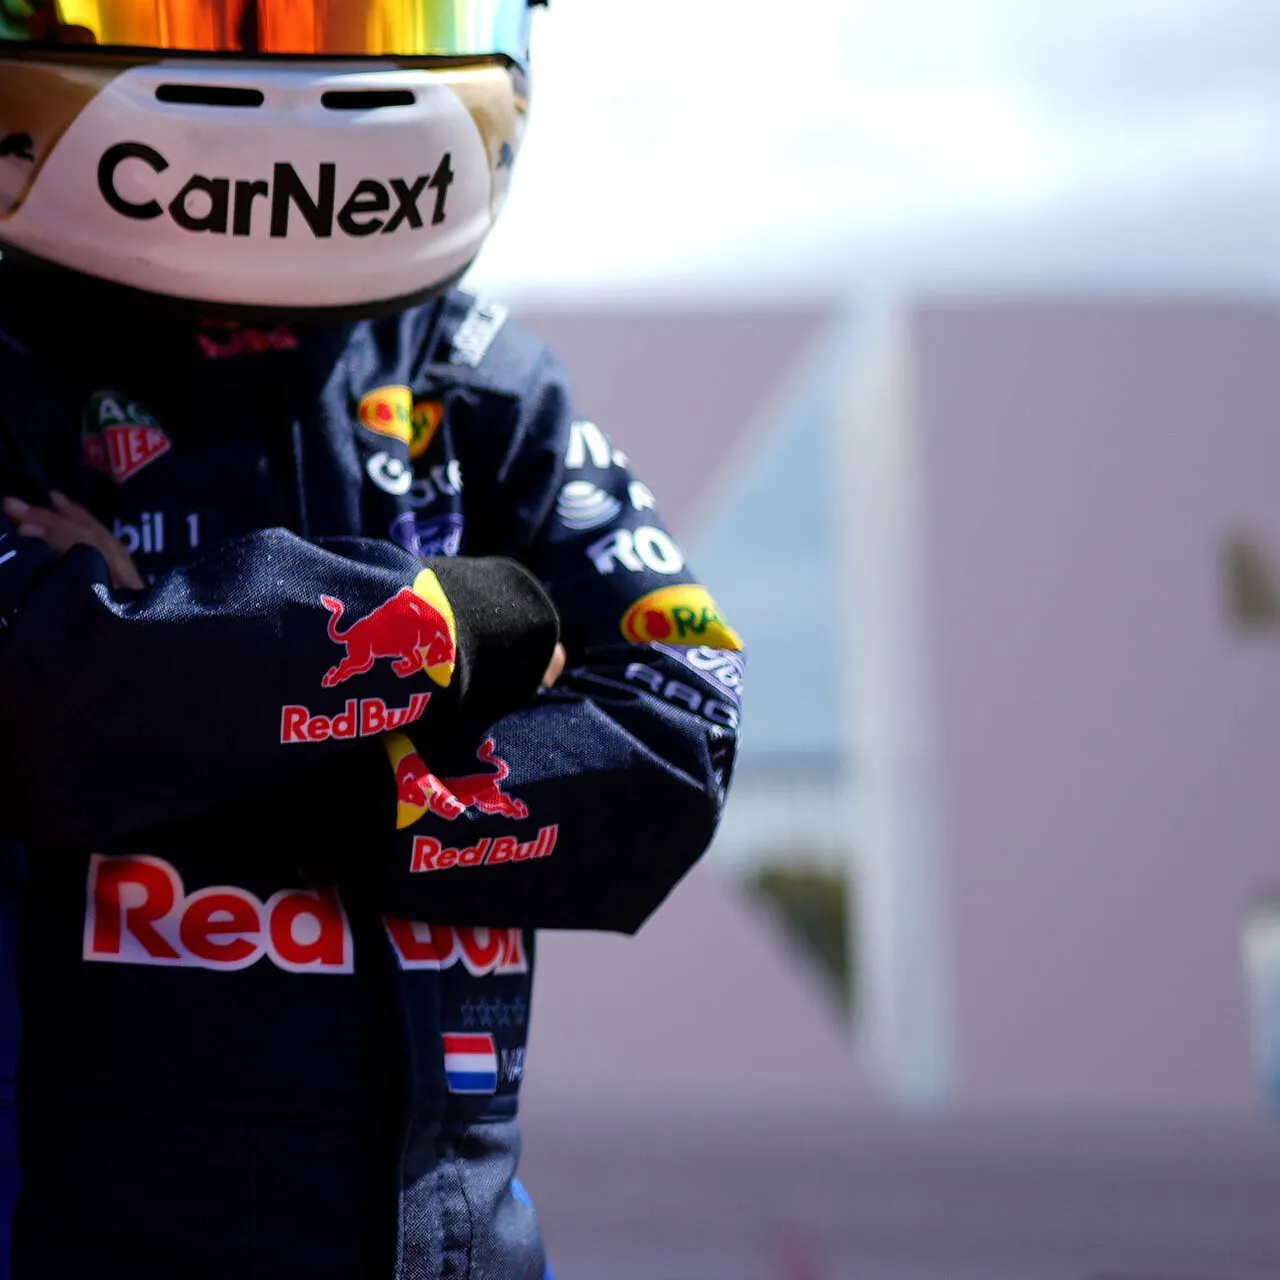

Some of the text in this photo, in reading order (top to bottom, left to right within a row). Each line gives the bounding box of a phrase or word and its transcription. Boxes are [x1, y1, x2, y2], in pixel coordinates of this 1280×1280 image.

[96, 141, 455, 238] CarNext
[113, 511, 200, 554] bil 1
[83, 853, 354, 974] Red
